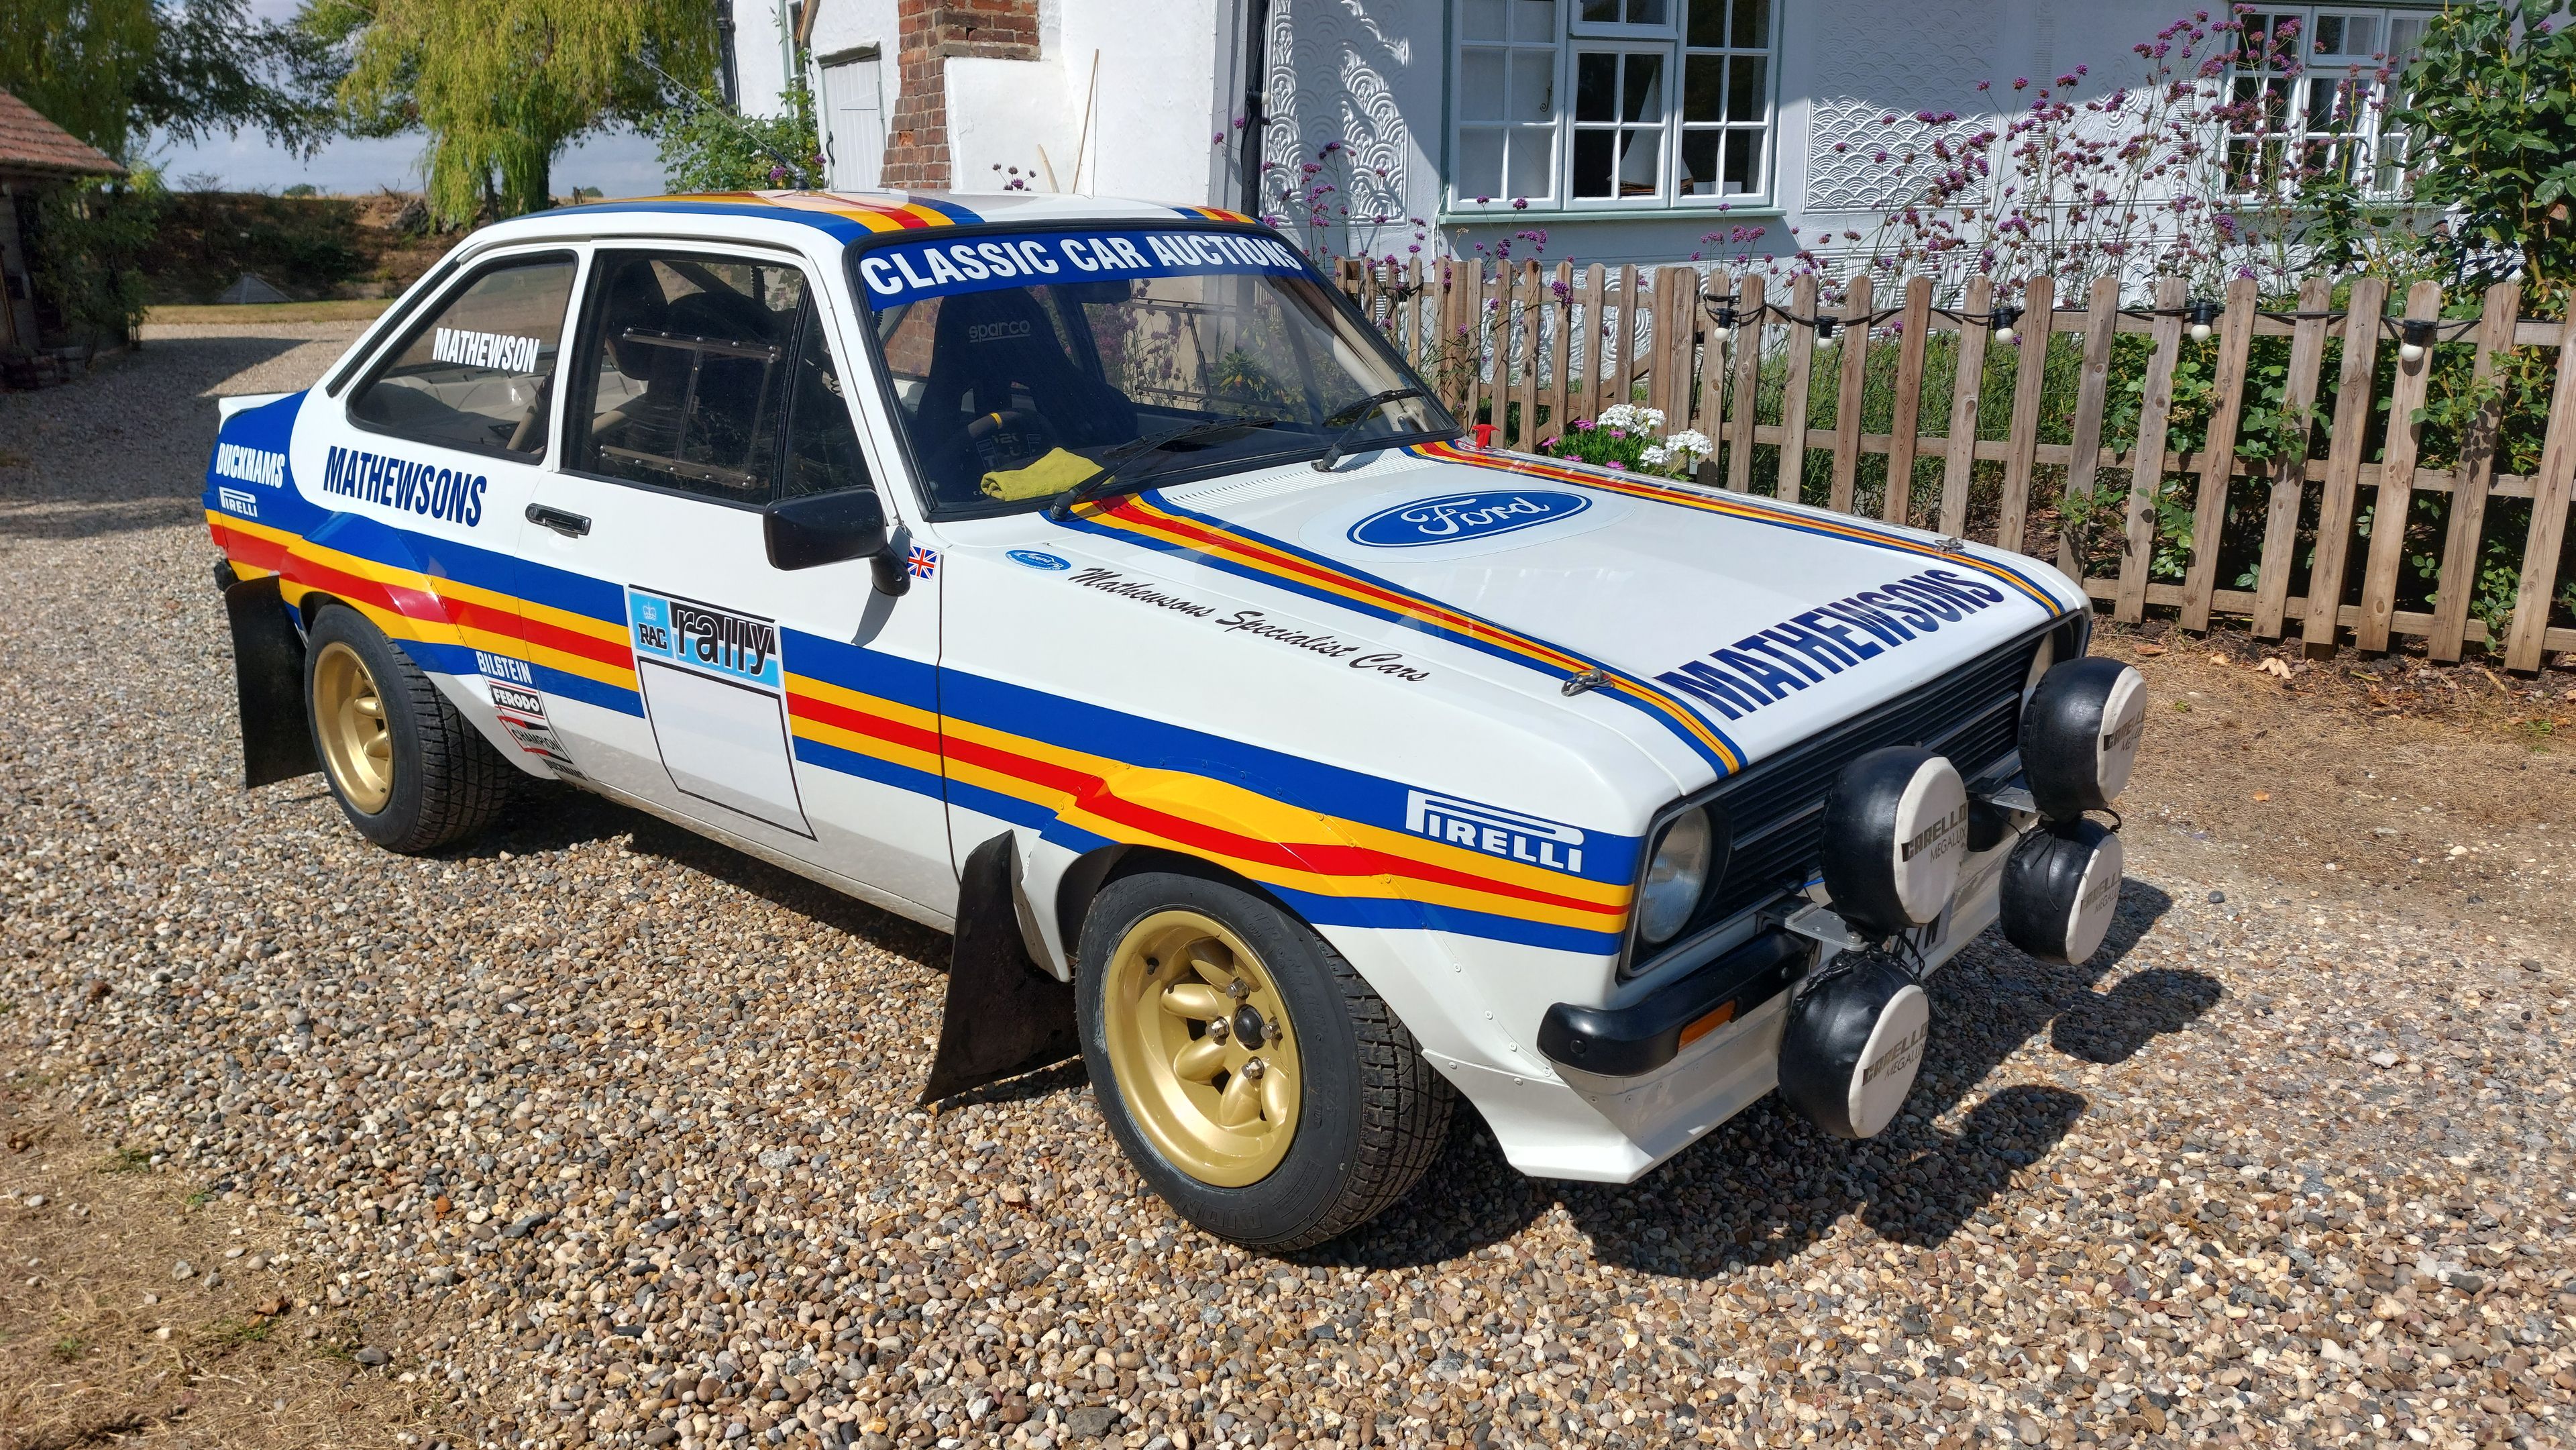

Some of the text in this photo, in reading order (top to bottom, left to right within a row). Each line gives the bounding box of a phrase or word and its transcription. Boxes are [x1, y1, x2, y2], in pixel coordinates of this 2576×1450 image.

[860, 236, 1303, 295] CLASSIC CAR AUCTIONS
[432, 327, 541, 373] MATHEWSON
[969, 320, 1030, 343] sparco
[215, 442, 286, 489] DUCKHAMS
[323, 446, 487, 527] MATHEWSONS
[219, 486, 258, 517] PIRELLI
[1400, 497, 1551, 535] Ford
[638, 609, 773, 676] RAC rally
[1067, 567, 1430, 682] Mathewsons Specialist Cars
[1652, 569, 2005, 721] MATHEWSONS
[475, 650, 533, 684] BILSTEIN
[492, 687, 539, 712] FERODO
[1405, 789, 1585, 873] PIRELLI
[1901, 802, 1967, 863] CARELLO
[1862, 1021, 1929, 1086] CARELLO
